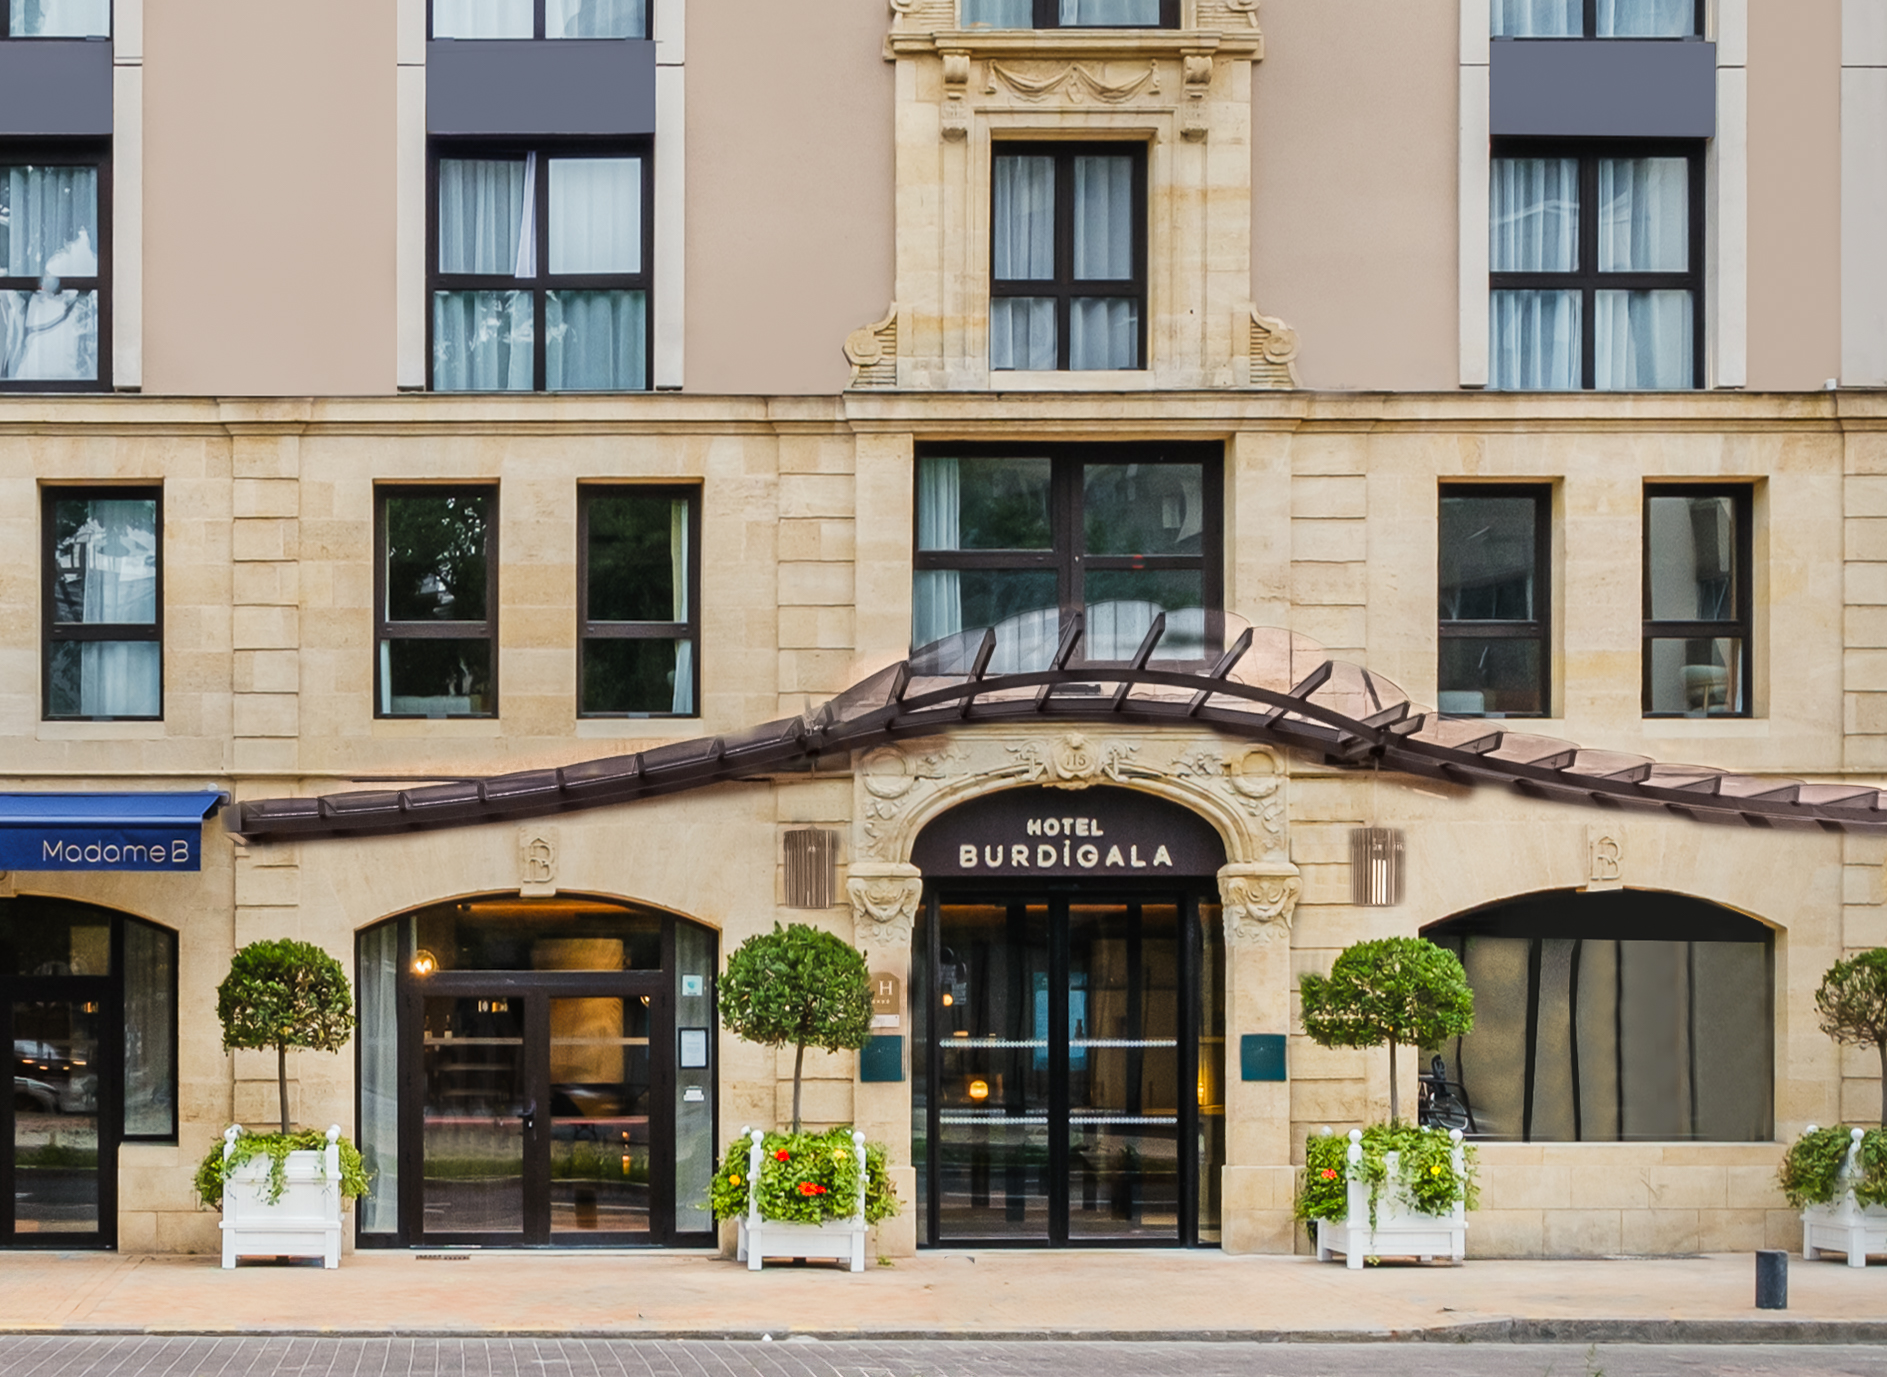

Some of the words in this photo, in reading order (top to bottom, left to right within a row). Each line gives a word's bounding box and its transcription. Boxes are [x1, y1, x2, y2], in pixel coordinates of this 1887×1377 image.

[1026, 817, 1104, 837] HOTEL
[959, 839, 1173, 868] BURDIGALA
[879, 980, 892, 996] H
